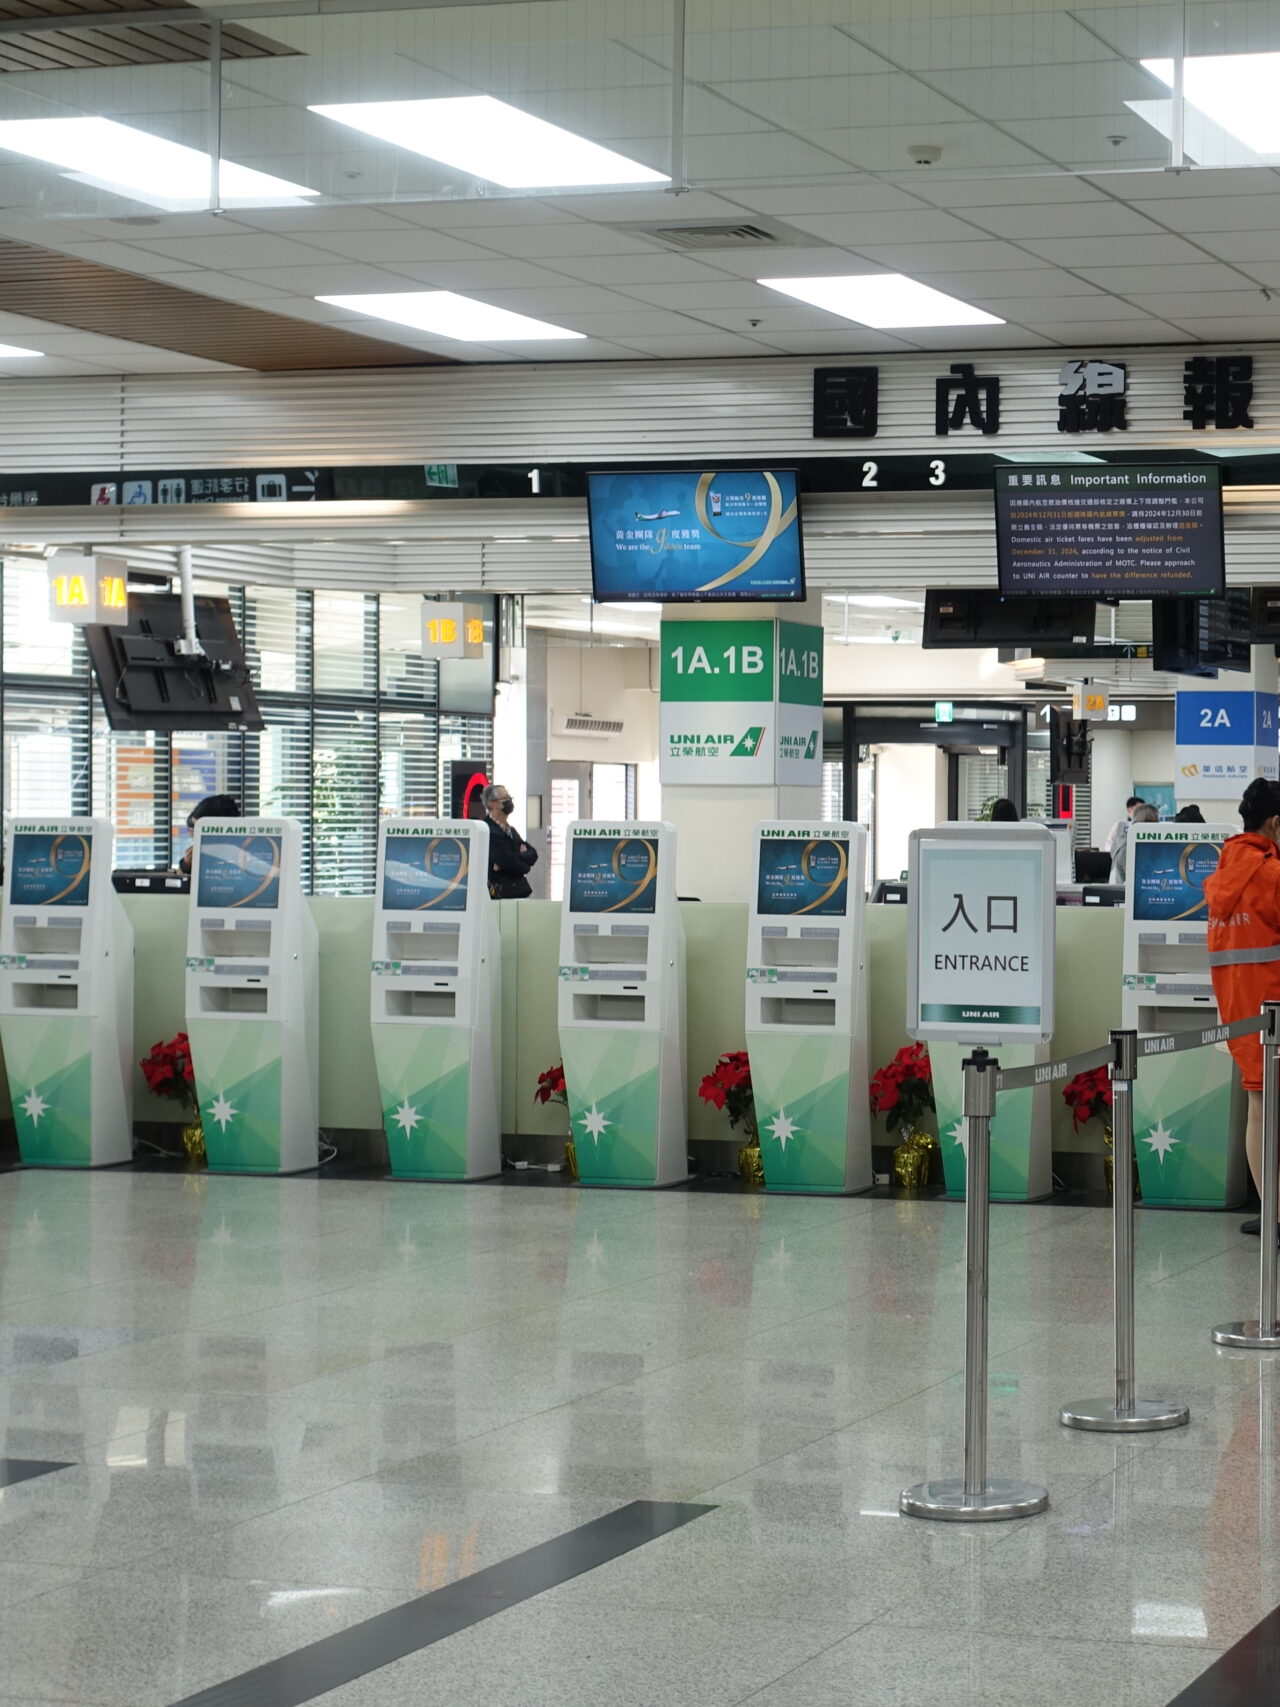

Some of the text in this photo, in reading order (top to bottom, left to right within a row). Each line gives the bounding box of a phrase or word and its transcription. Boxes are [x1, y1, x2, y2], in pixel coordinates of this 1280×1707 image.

[862, 462, 877, 487] 2
[929, 460, 946, 486] 3
[1008, 472, 1207, 487] 重要訊息 Important Information
[528, 469, 540, 494] 1
[684, 543, 701, 551] team
[53, 575, 88, 606] 1A
[426, 619, 456, 643] 1B
[671, 646, 764, 674] 1A.1B
[1200, 708, 1231, 728] 2A
[1262, 710, 1272, 729] 2A
[670, 734, 735, 744] UNI AIR
[670, 746, 719, 757] 立榮航空
[15, 825, 93, 833] UNI AIR 立榮航空
[202, 825, 282, 834] UNI AIR 立榮航空
[387, 827, 470, 836] UNI AIR 立榮航空
[573, 828, 659, 837] UNI AIR 立榮航空
[761, 829, 850, 838] UNI AIR 立榮航空
[1136, 832, 1230, 841] UNI AIR 立榮航空
[941, 893, 1018, 934] 入口
[1229, 913, 1251, 929] AIR
[935, 954, 1029, 972] ENTRANCE
[961, 1010, 1000, 1018] UNI AIR
[1202, 1026, 1230, 1043] UNI AIR
[1145, 1037, 1175, 1053] UNI AIR
[1035, 1062, 1068, 1083] UNI AIR
